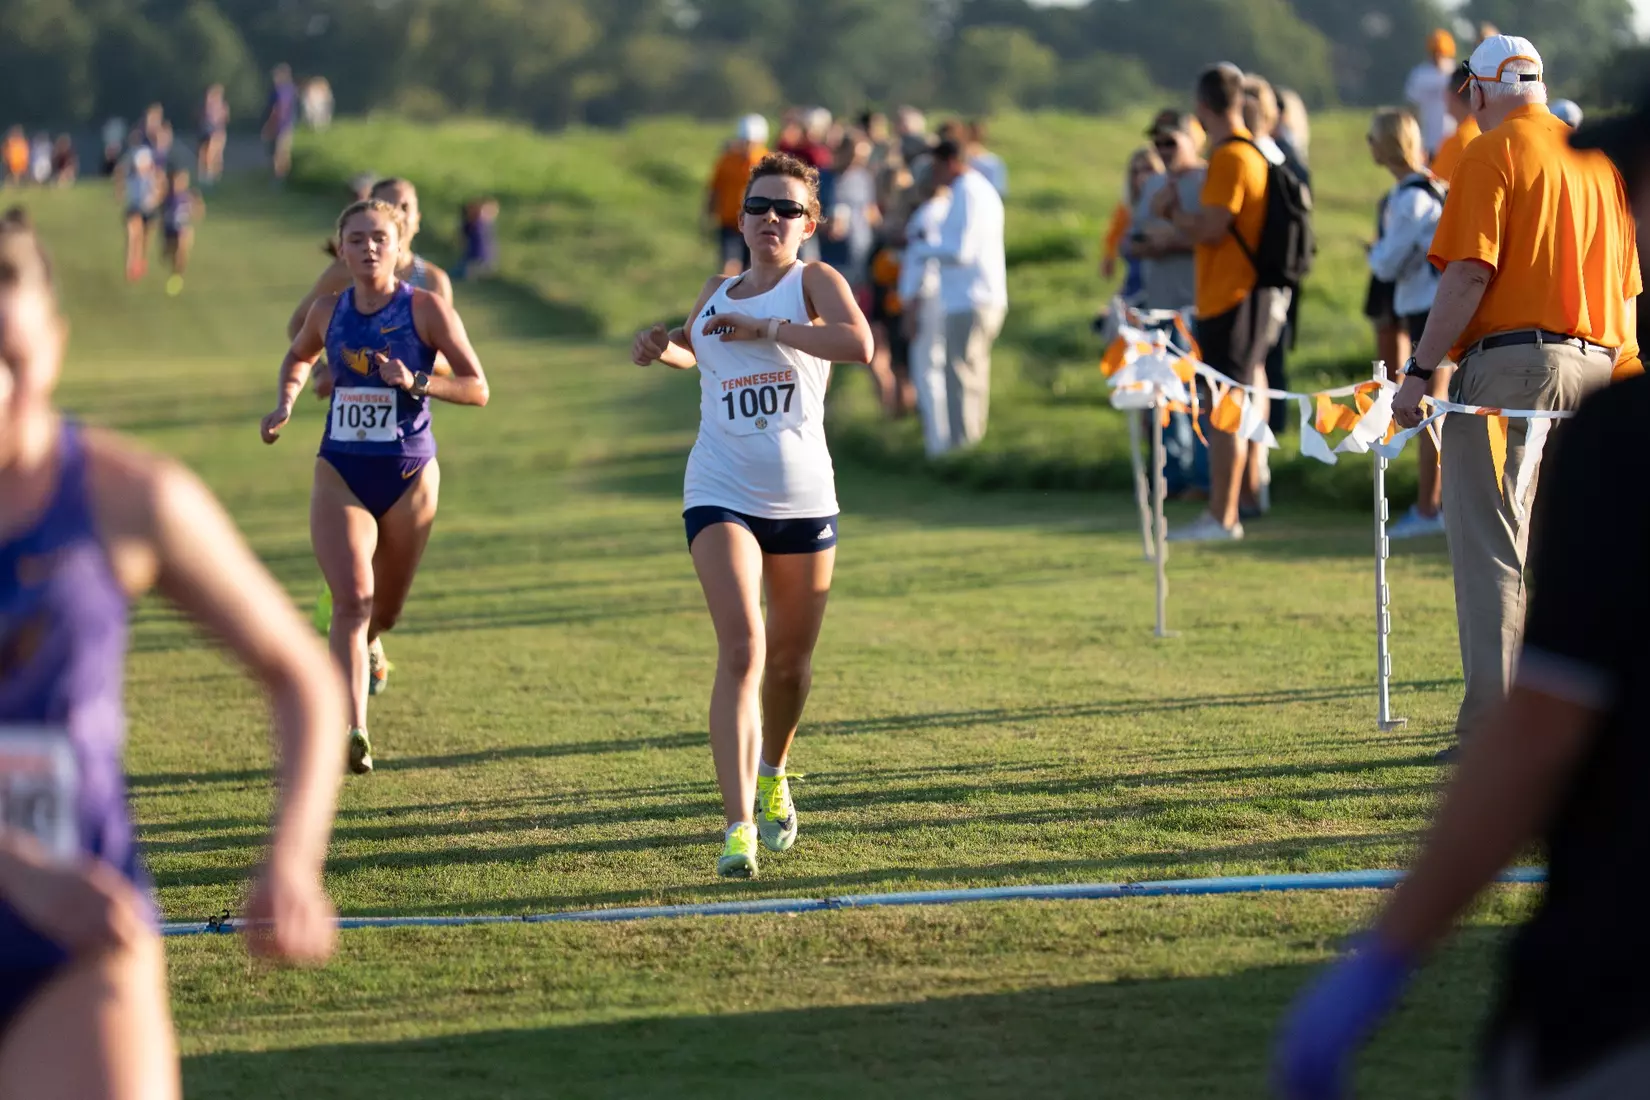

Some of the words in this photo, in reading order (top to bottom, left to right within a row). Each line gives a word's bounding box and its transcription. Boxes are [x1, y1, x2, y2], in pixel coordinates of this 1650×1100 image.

[721, 370, 793, 391] TENNESSEE
[721, 383, 795, 420] 1007
[336, 403, 392, 428] 1037
